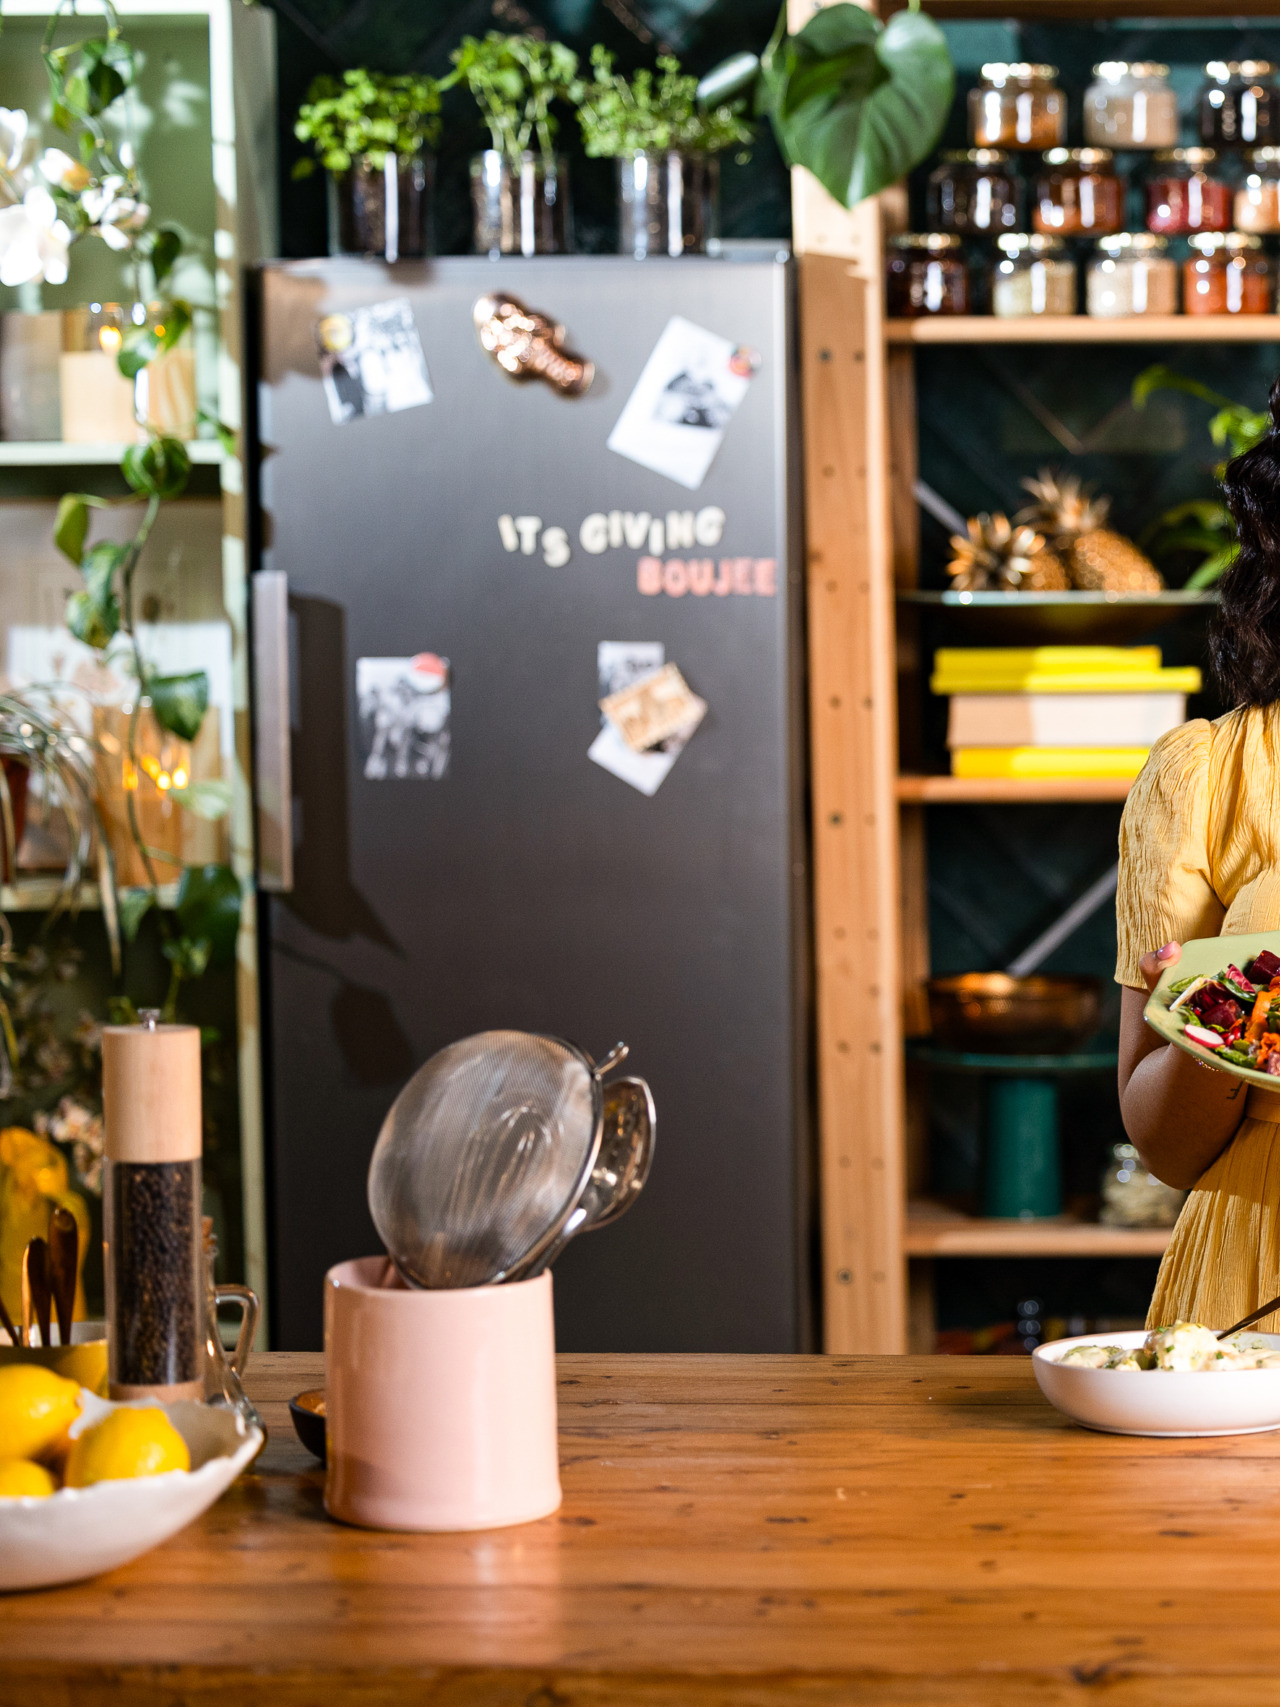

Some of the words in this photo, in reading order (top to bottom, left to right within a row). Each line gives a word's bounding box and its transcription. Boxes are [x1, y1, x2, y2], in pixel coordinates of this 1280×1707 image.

[497, 514, 571, 568] ITS
[579, 505, 726, 556] GIVING
[636, 556, 778, 597] BOUJEE
